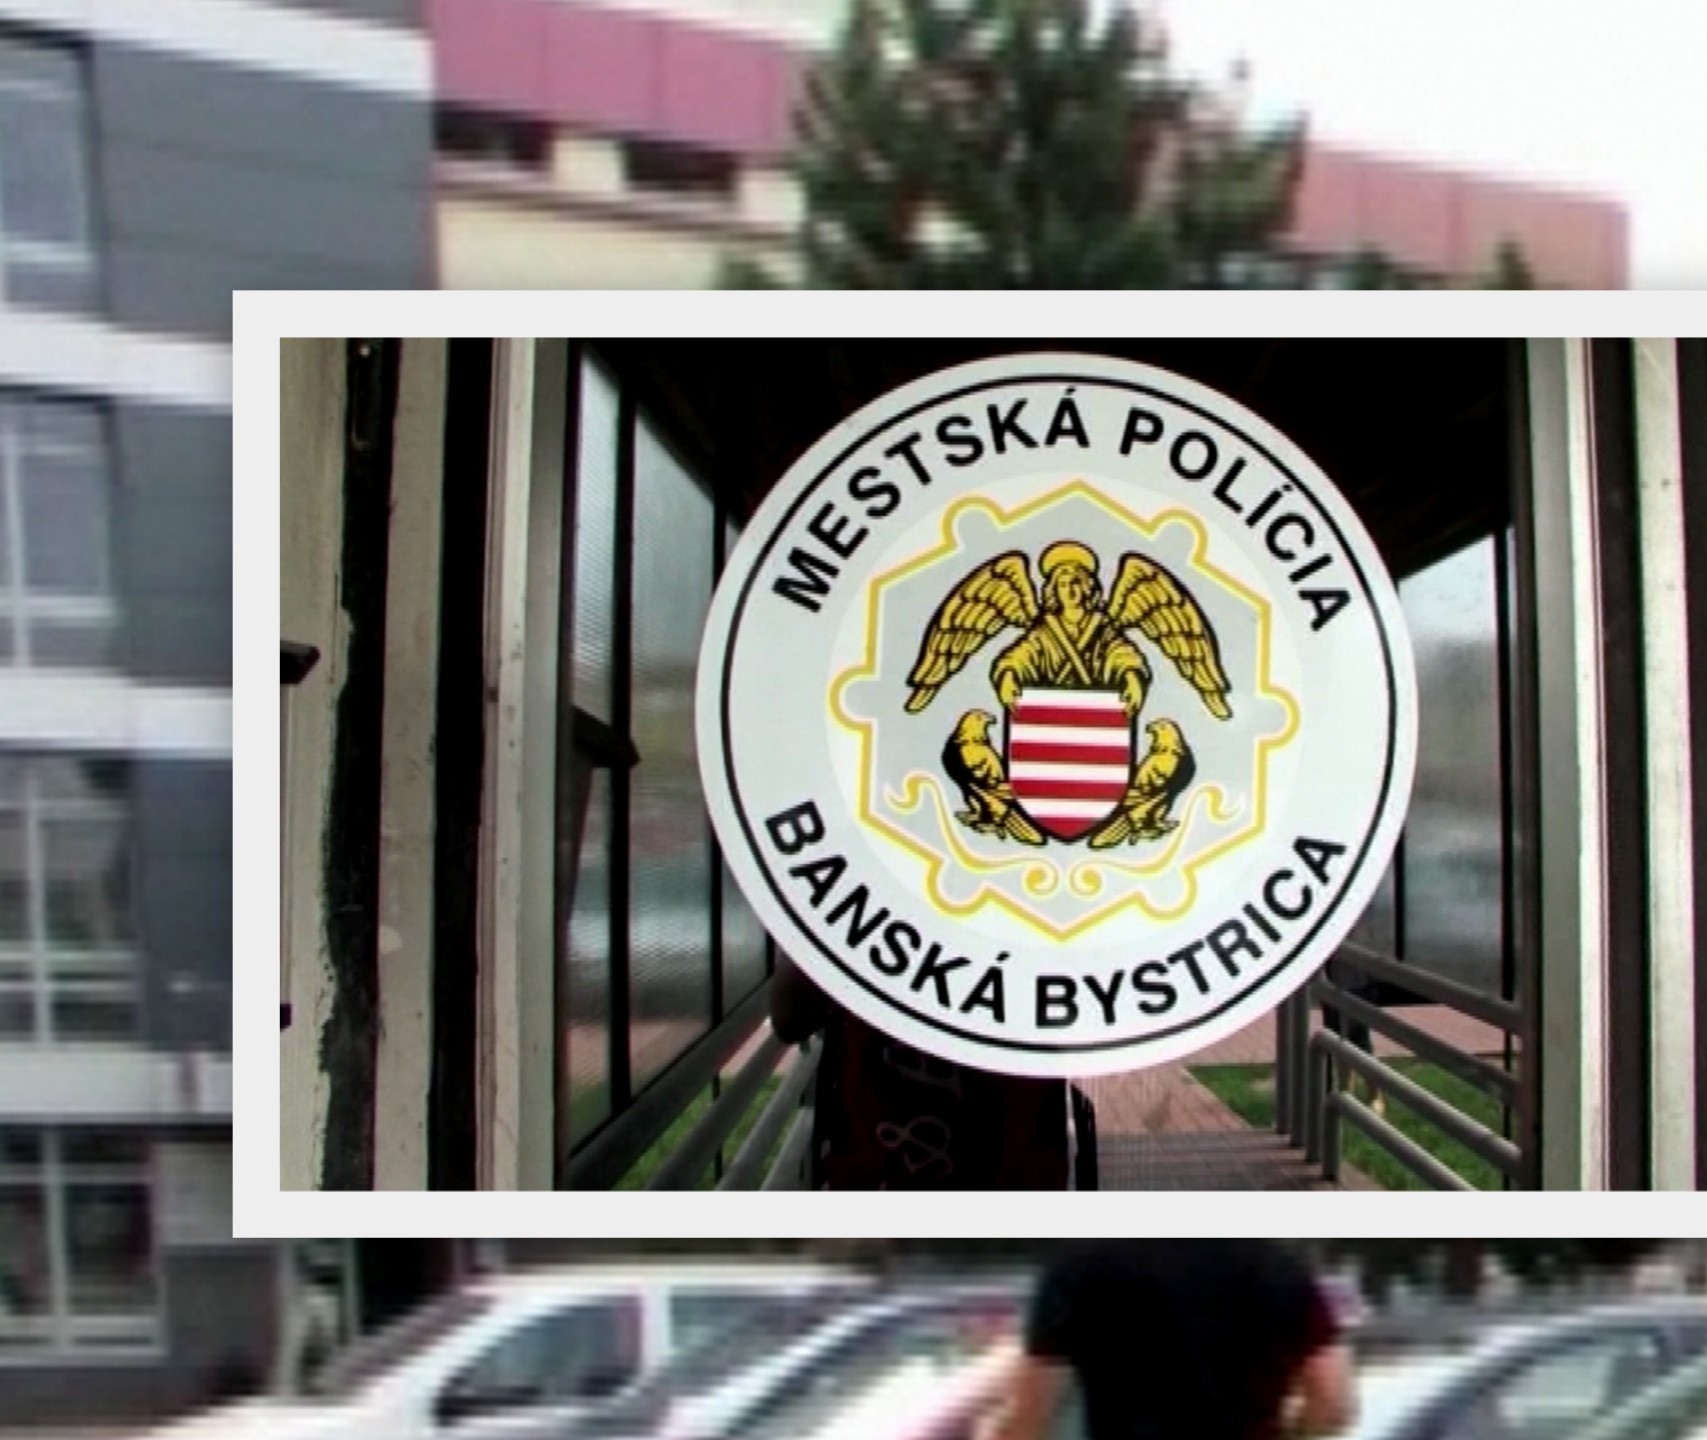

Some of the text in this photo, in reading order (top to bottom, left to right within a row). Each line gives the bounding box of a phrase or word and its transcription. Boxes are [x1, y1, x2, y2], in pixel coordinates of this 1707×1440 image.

[772, 388, 1351, 632] MESTSKÁ POLÍCIA
[765, 800, 1346, 1029] BANSKÁ BYSTRICA
